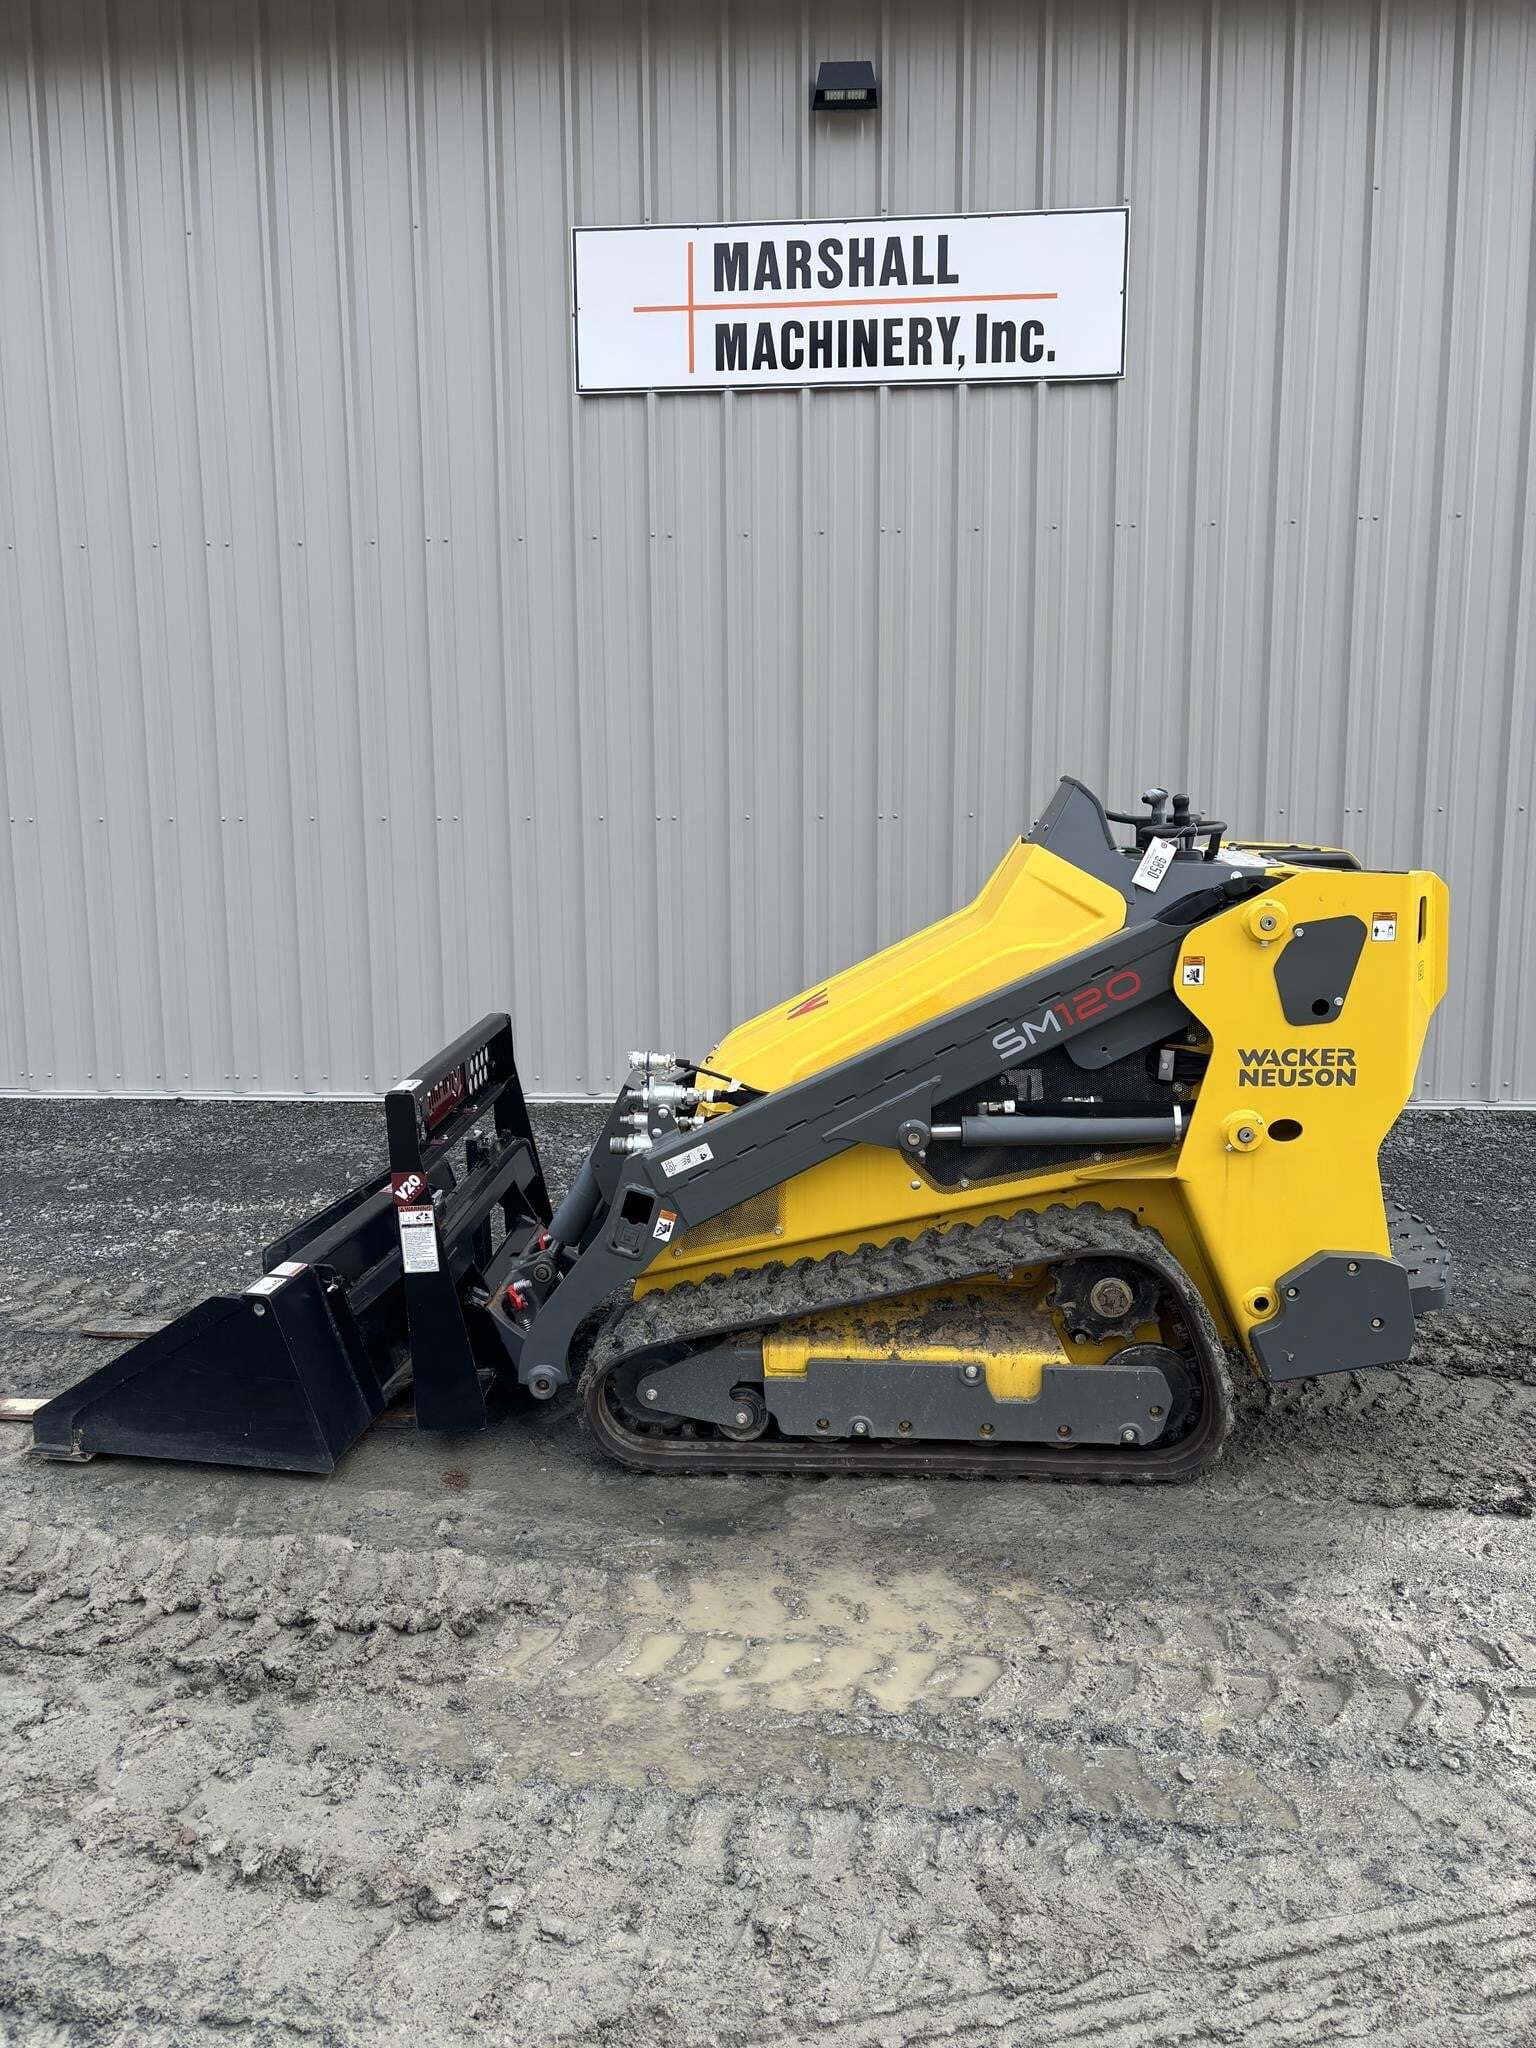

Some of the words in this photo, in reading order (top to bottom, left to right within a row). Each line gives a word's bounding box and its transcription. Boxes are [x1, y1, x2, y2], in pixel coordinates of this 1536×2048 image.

[713, 234, 959, 292] MARSHALL
[715, 316, 966, 371] MACHINERY,
[975, 313, 1056, 364] Inc.
[992, 970, 1142, 1060] SM120
[1238, 1048, 1357, 1068] WACKER
[1238, 1068, 1357, 1087] NEUSON
[394, 1174, 421, 1201] V20
